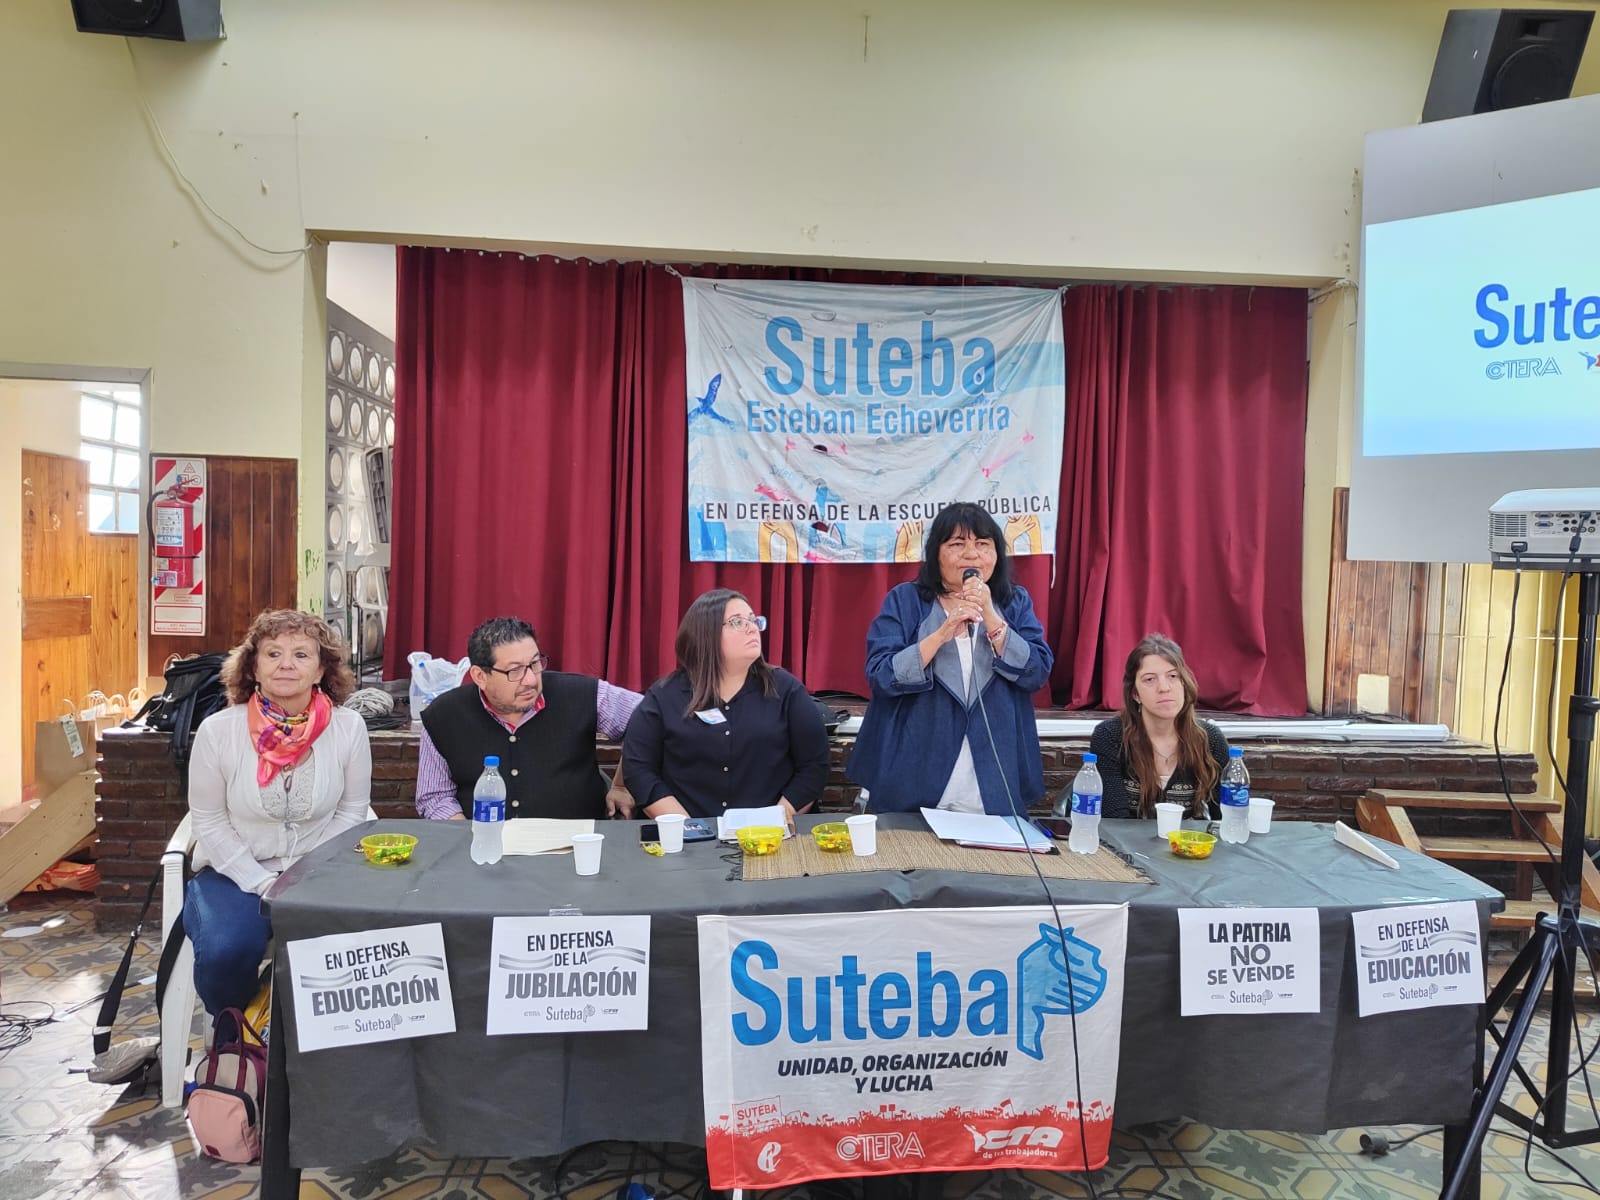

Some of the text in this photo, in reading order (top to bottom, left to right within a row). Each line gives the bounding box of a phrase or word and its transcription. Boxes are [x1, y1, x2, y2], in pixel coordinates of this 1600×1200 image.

[1474, 283, 1600, 349] Sute
[763, 316, 996, 397] Suteba
[1485, 357, 1562, 380] CTERA
[747, 399, 1010, 434] Esteban Echeverría
[706, 502, 728, 519] EN
[737, 503, 819, 521] DEFENSA
[827, 504, 850, 521] DE
[858, 504, 880, 521] LA
[888, 501, 953, 521] ESCUE
[1208, 922, 1291, 943] LA PATRIA
[1378, 916, 1449, 941] EN DEFENSA
[527, 930, 614, 952] EN DEFENSA
[1401, 937, 1429, 952] DE LA
[325, 940, 411, 970] EN DEFENSA
[554, 951, 588, 967] DE LA
[1230, 943, 1271, 967] NO
[1367, 948, 1471, 984] EDUCACIÓN
[353, 963, 388, 981] DE LA
[505, 966, 637, 999] JUBILACIÓN
[1207, 964, 1295, 985] SE VENDE
[312, 975, 440, 1016] EDUCACIÓN
[730, 939, 1009, 1046] Suteba
[1229, 990, 1262, 1004] Suteba
[1400, 986, 1429, 1000] Suteba
[354, 1017, 391, 1033] Suteba
[546, 1006, 583, 1021] Suteba
[777, 1047, 1008, 1077] UNIDAD, ORGANIZACIÓN
[855, 1074, 933, 1093] Y LUCHA
[737, 1103, 777, 1121] SUTEBA
[836, 1131, 926, 1162] CTERA
[982, 1126, 1064, 1149] CTA
